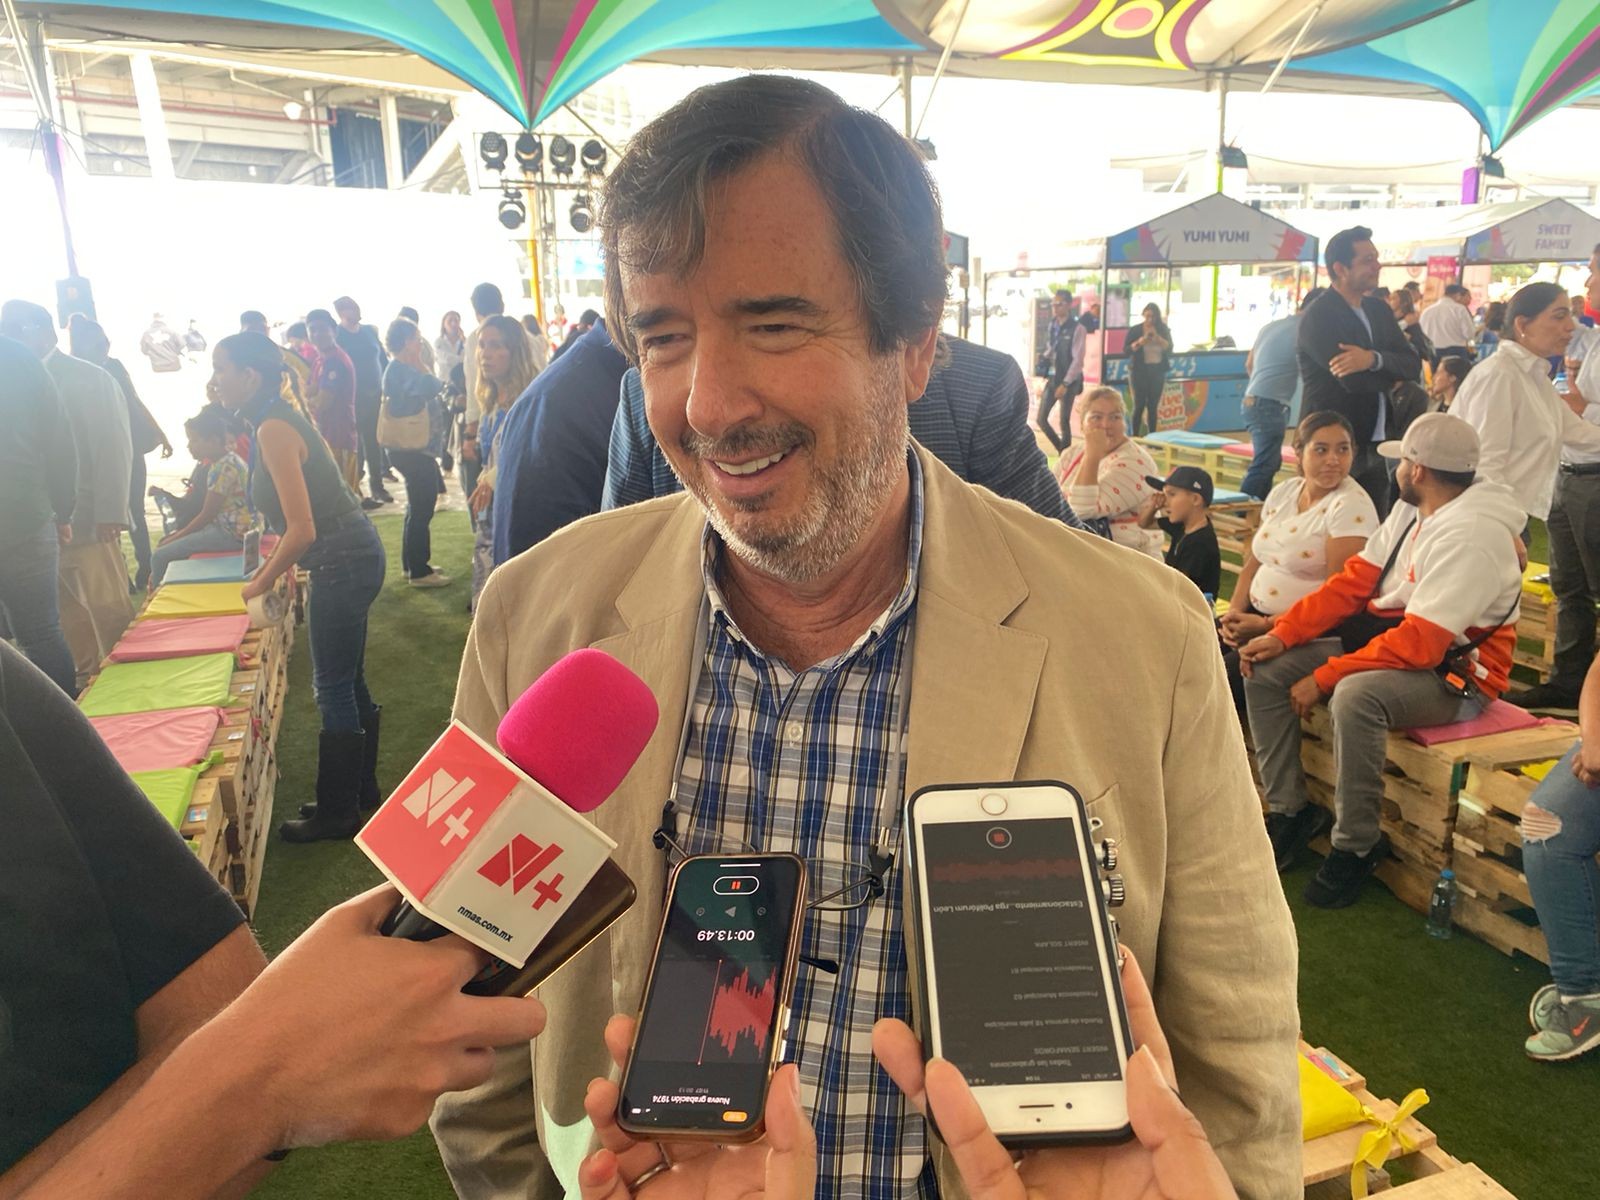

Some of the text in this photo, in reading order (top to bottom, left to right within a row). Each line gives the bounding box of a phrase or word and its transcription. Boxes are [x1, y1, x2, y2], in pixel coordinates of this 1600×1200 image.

[1536, 224, 1572, 235] SWEET
[1183, 230, 1250, 243] YUMI YUMI
[1535, 238, 1572, 250] FAMILY
[933, 905, 954, 914] León
[955, 903, 995, 914] Polifórum
[457, 905, 513, 943] nmas.com.mx
[697, 930, 755, 941] 00:13.49
[652, 1094, 731, 1105] Nueva grabación 1974
